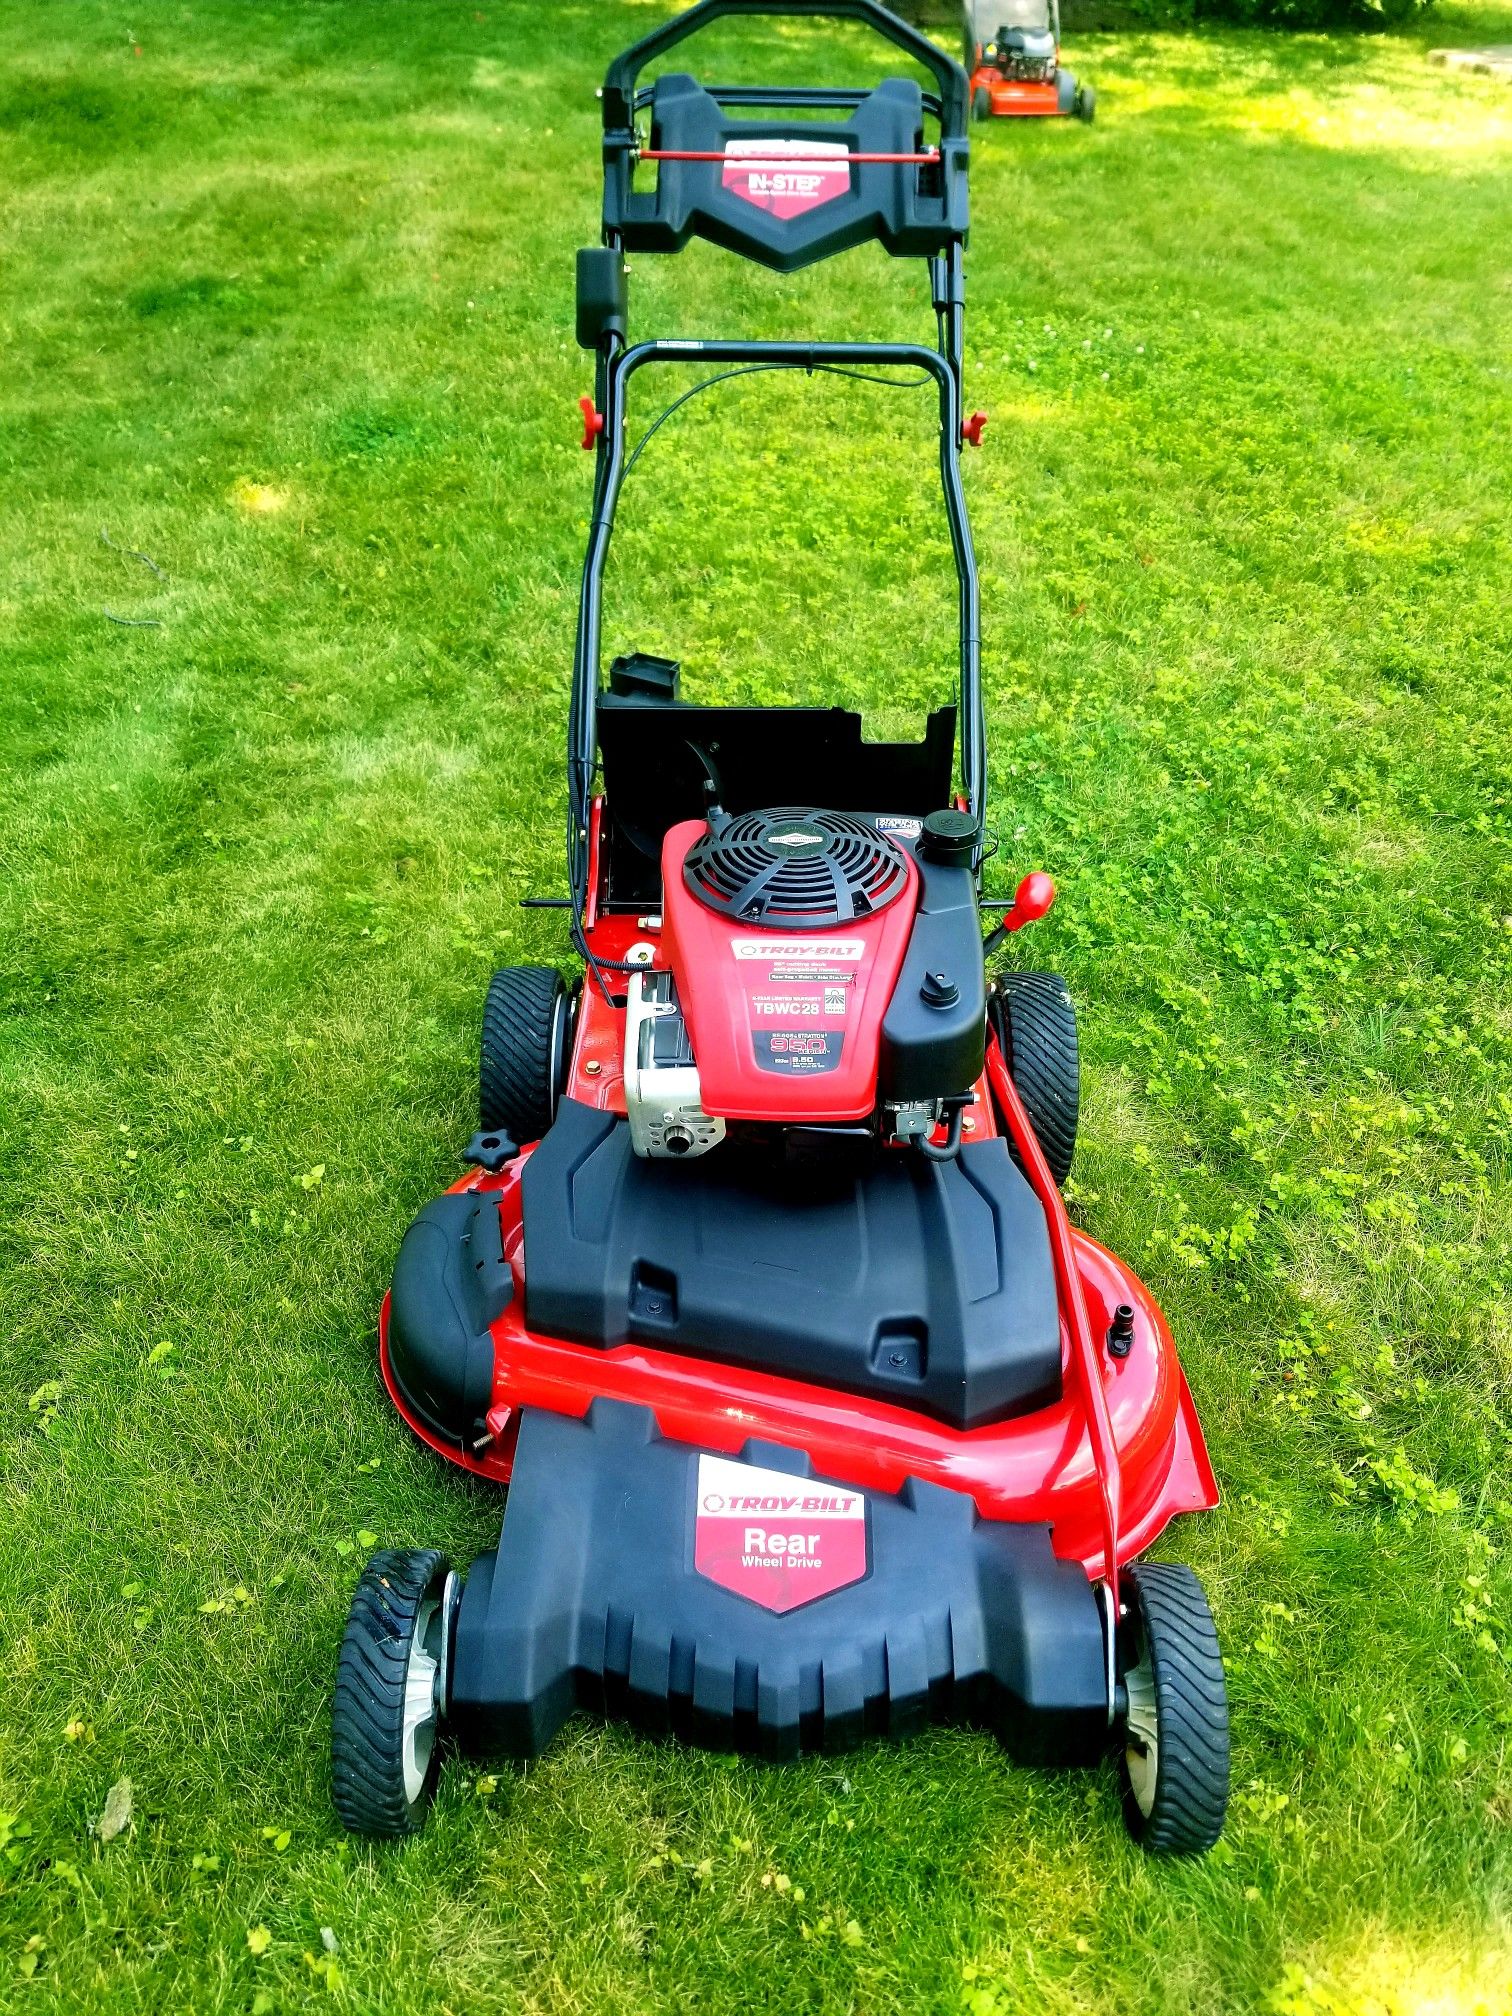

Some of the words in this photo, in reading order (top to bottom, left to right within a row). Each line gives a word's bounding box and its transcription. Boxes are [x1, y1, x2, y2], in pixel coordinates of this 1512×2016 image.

[759, 946, 857, 956] TROY-BILT
[754, 1002, 820, 1015] TBWC28
[770, 1037, 826, 1053] 950
[728, 1496, 857, 1511] TROY-BILT
[744, 1527, 821, 1555] Rear
[741, 1555, 783, 1568] Wheel
[787, 1556, 823, 1568] Drive
